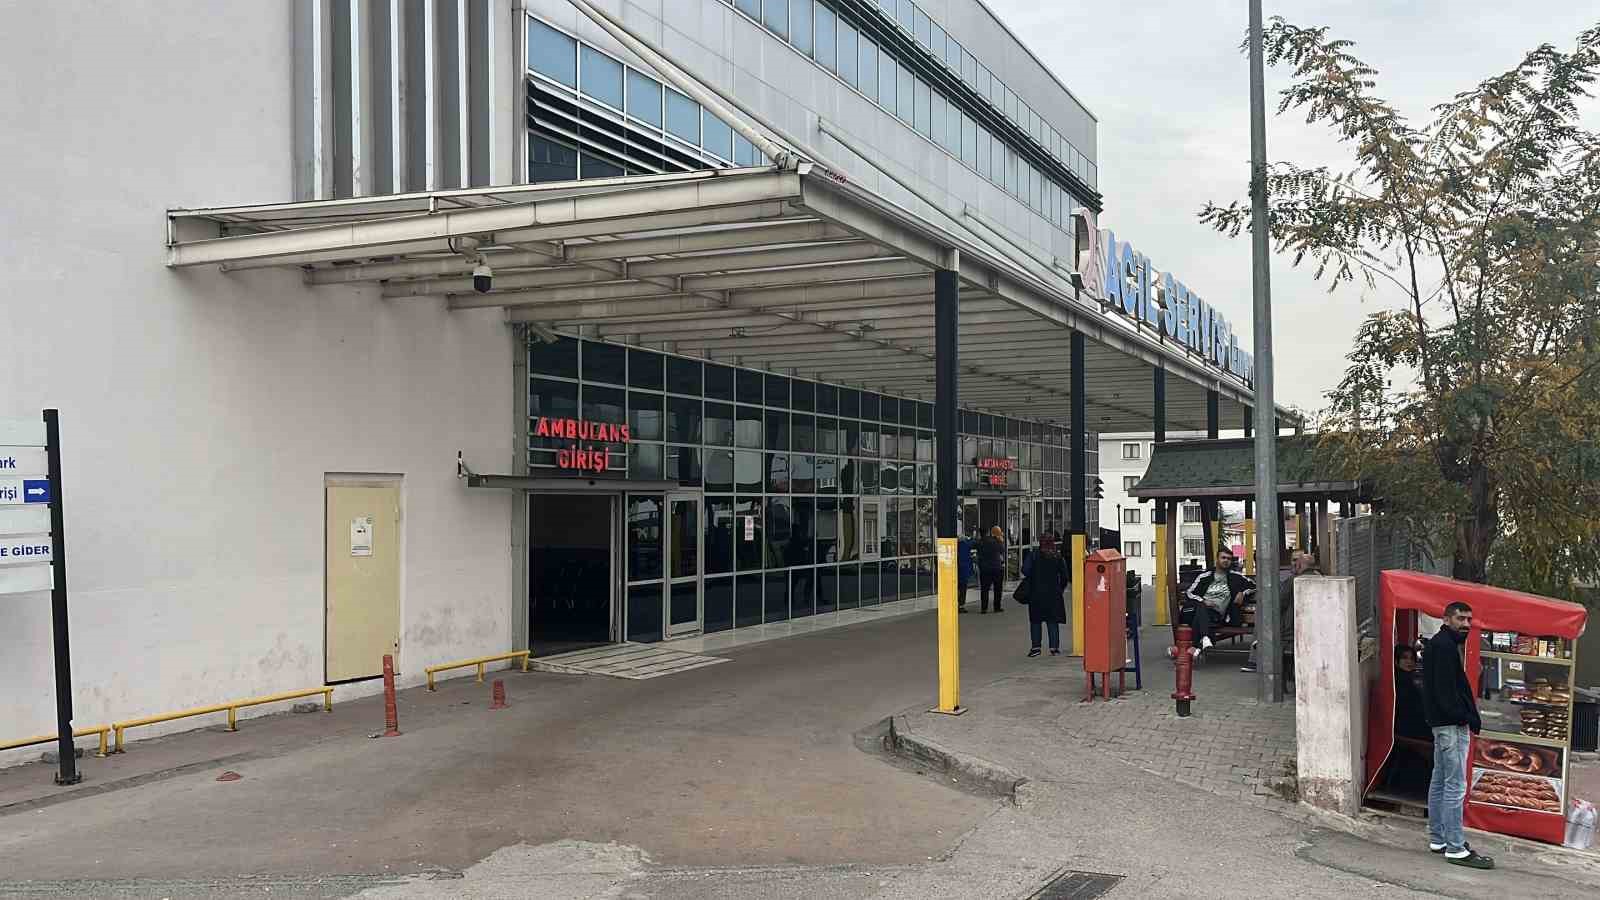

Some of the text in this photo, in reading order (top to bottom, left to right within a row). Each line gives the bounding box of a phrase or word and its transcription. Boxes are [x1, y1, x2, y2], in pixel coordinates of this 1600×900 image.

[536, 417, 630, 443] AMBULANS
[559, 444, 608, 473] GİRİŞİ
[12, 544, 50, 556] GİDER
